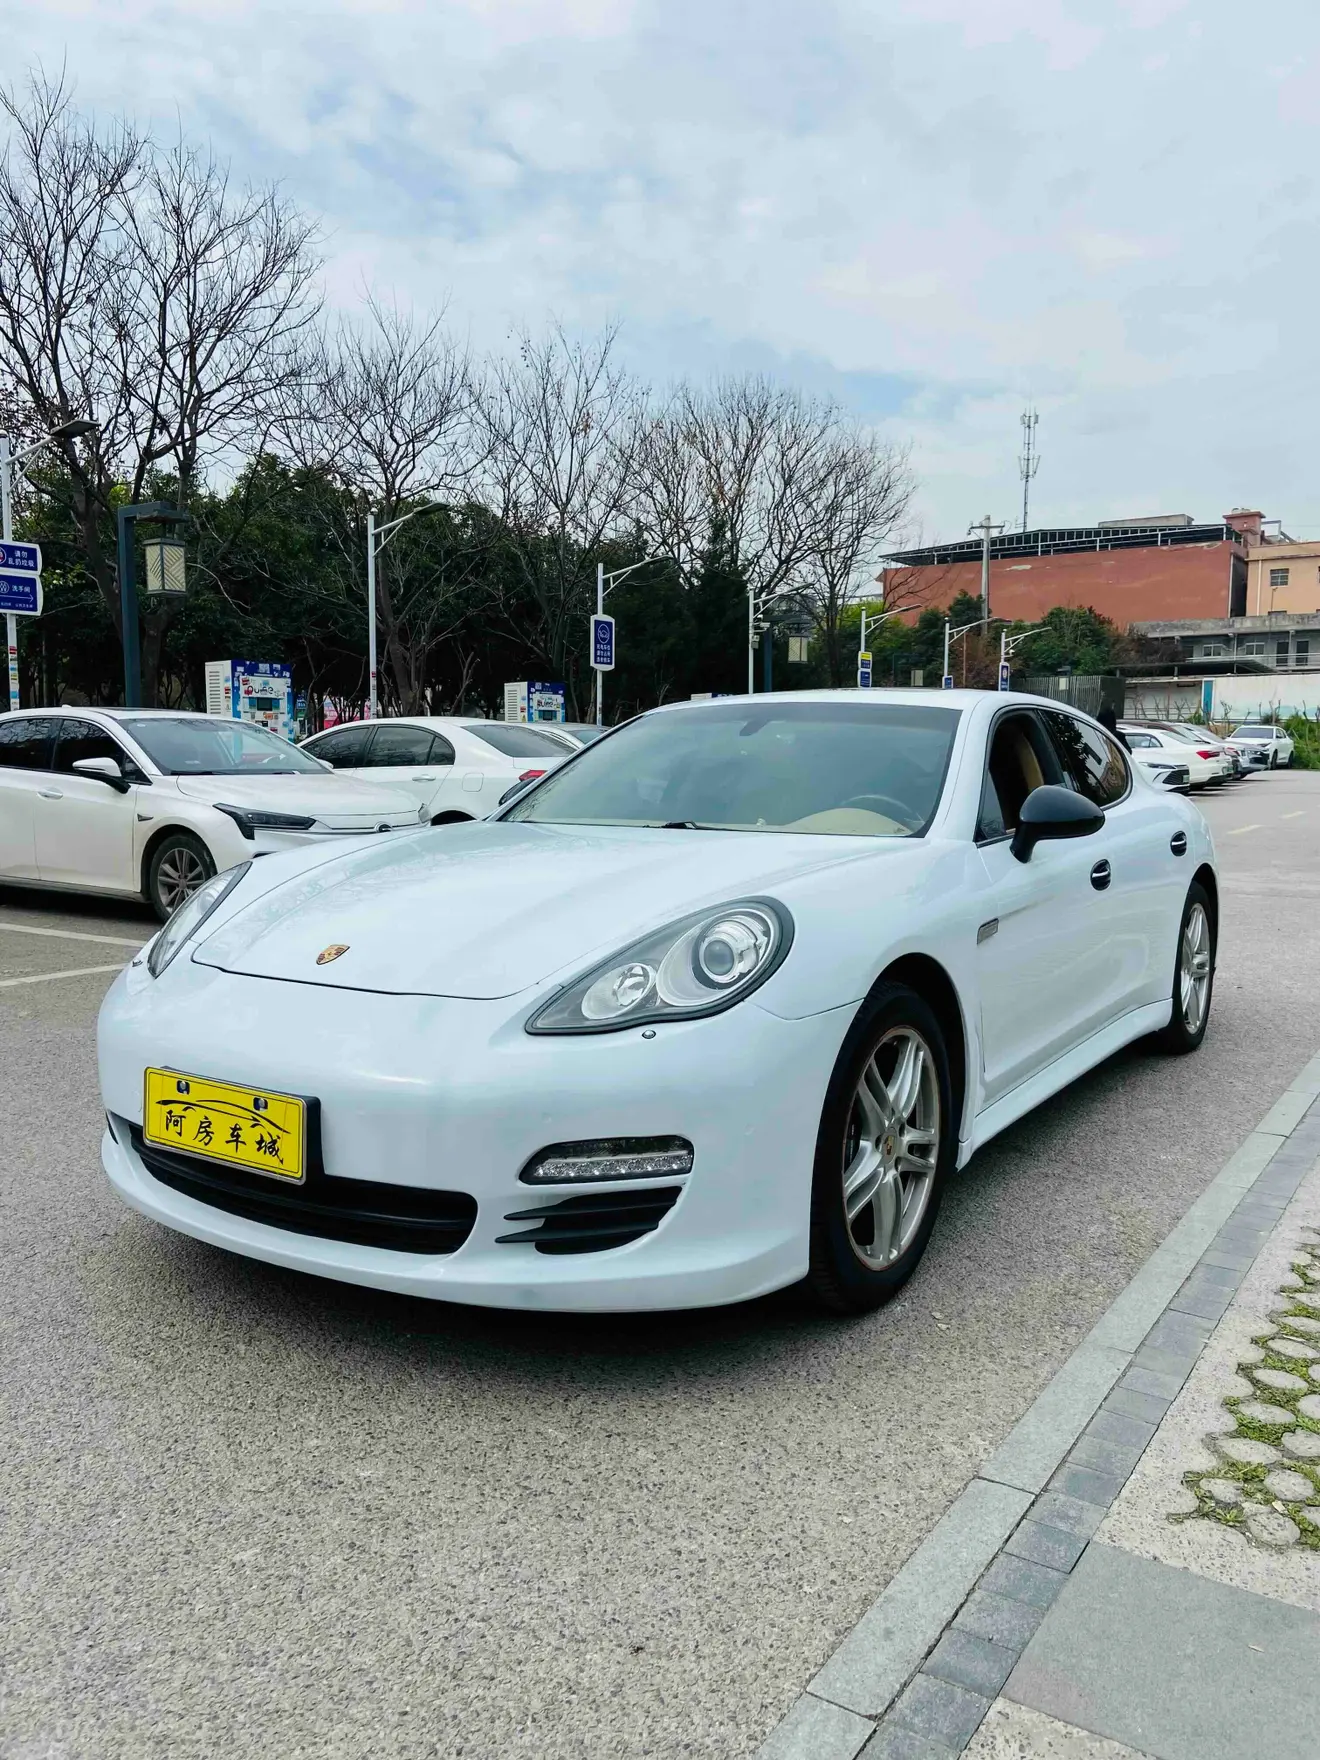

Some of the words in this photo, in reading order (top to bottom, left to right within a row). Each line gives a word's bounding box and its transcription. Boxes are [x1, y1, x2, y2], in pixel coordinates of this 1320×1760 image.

[14, 550, 28, 558] 请勿
[8, 557, 35, 567] 乱扔垃圾
[11, 585, 31, 593] 洗手间
[165, 1109, 284, 1165] 阿房车城
